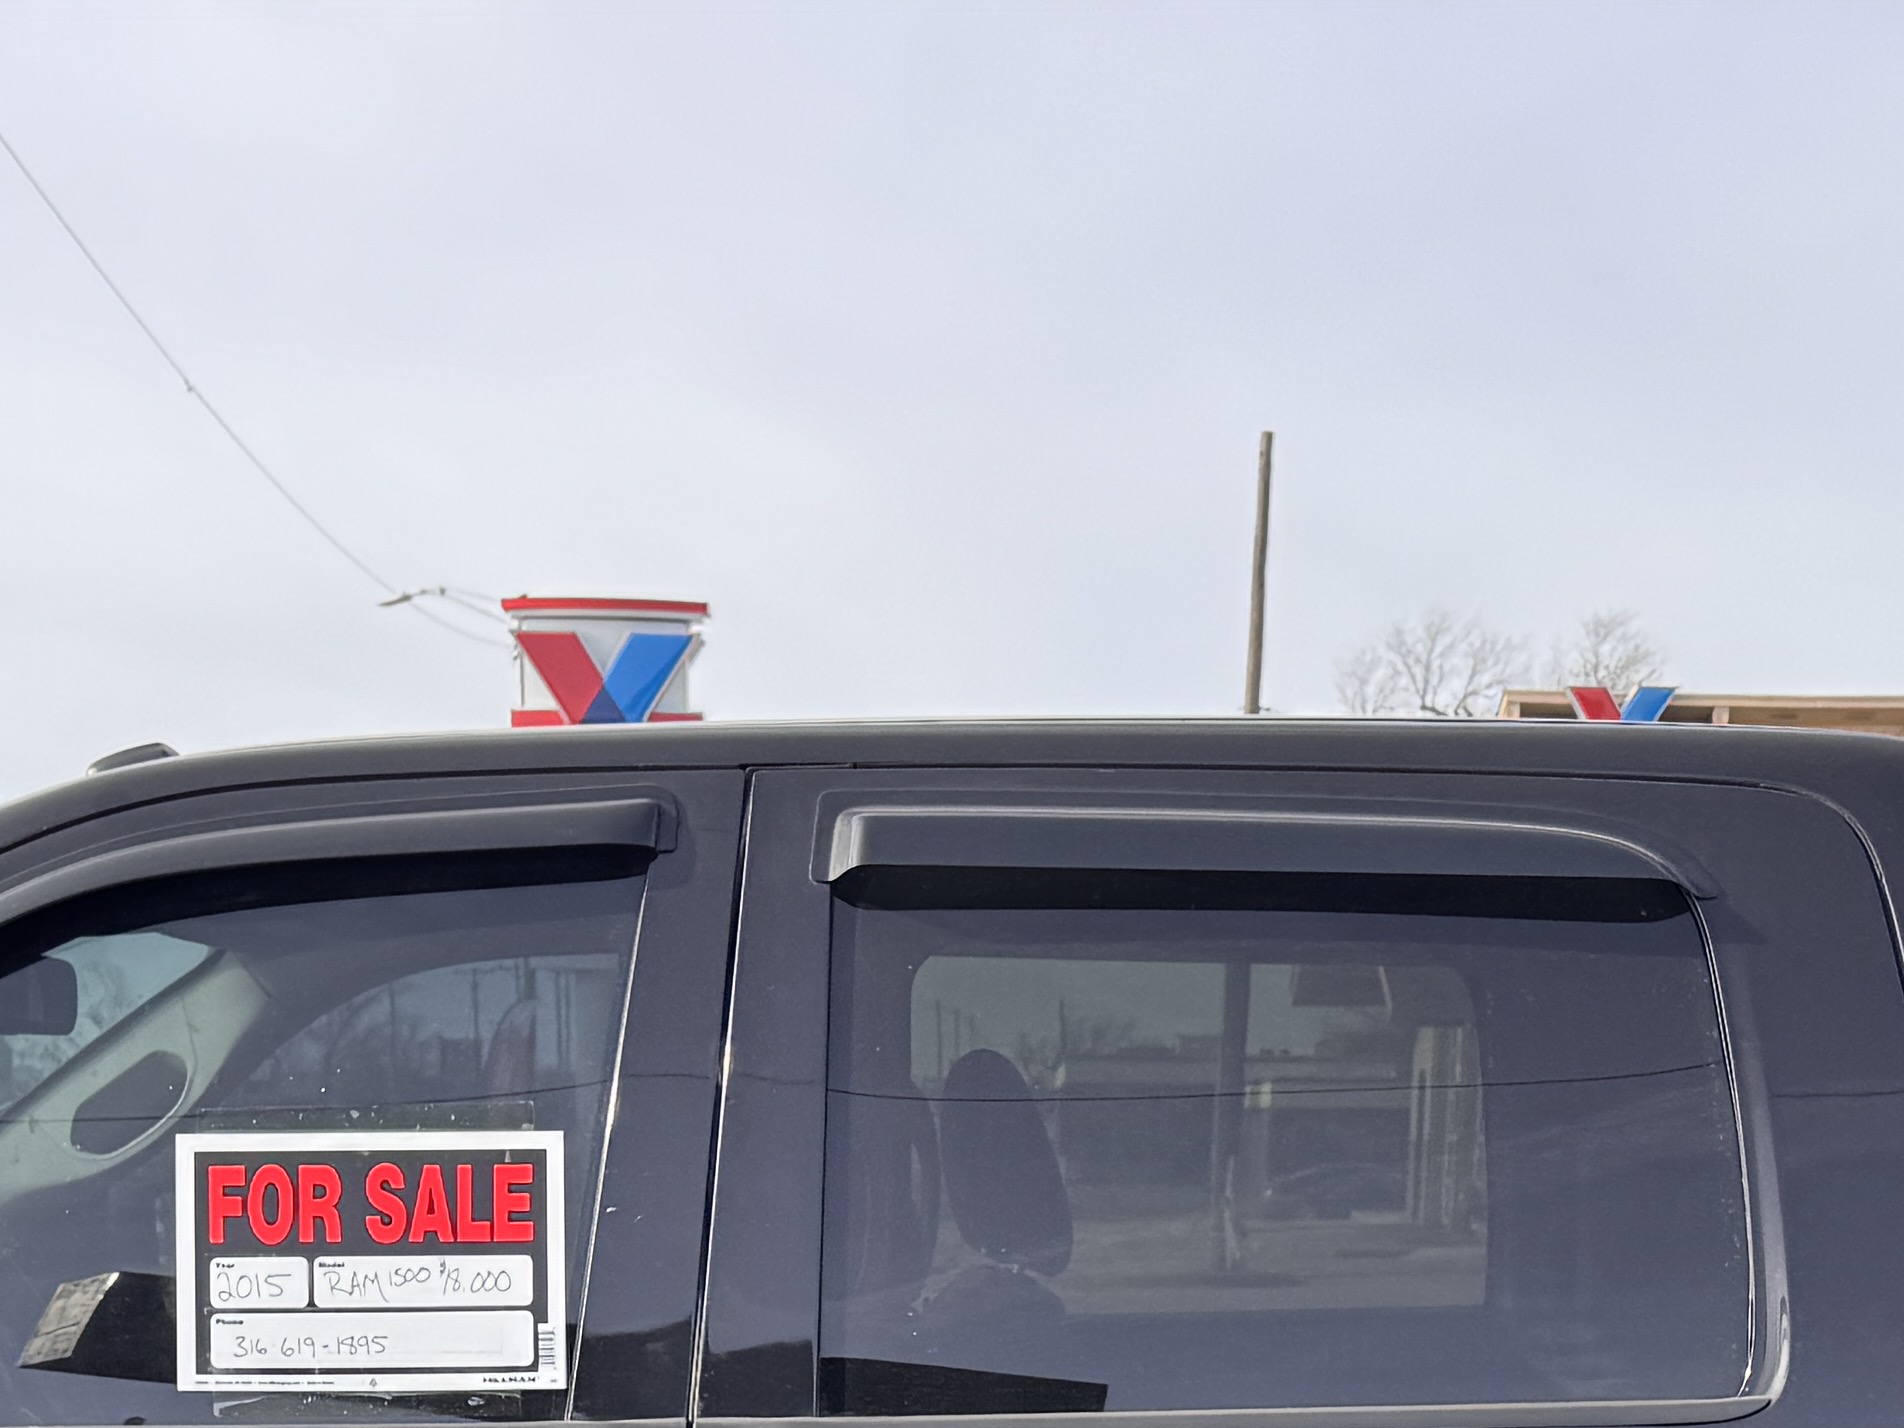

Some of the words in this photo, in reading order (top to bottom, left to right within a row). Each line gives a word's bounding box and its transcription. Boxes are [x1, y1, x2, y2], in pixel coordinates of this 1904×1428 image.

[207, 1163, 342, 1246] FOR
[364, 1161, 535, 1245] SALE
[217, 1272, 292, 1301] 2015
[323, 1270, 389, 1303] RAM
[388, 1266, 431, 1288] 1500
[233, 1336, 268, 1358] 316
